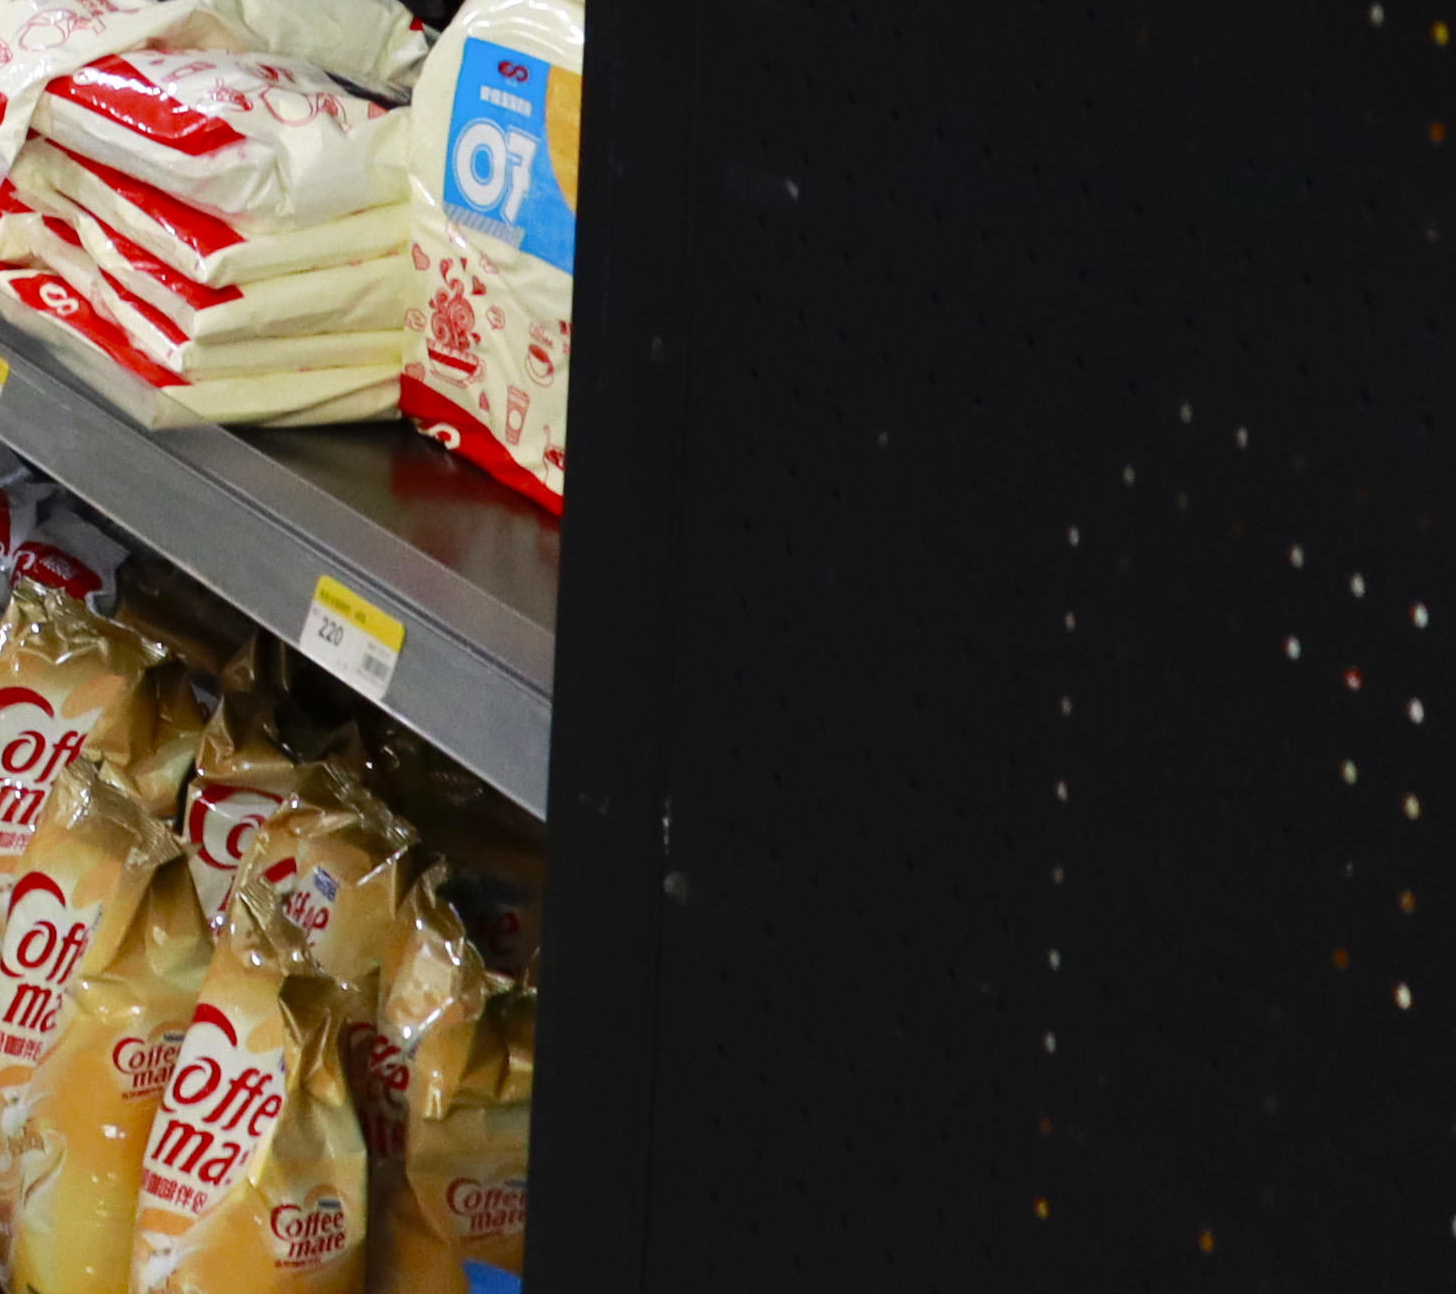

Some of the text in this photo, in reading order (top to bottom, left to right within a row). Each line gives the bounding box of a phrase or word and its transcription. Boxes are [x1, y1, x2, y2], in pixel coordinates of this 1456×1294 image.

[451, 118, 539, 226] 07
[0, 870, 86, 985] Coff
[3, 982, 58, 1032] ma
[151, 1118, 250, 1185] ma
[270, 1203, 343, 1242] Coffee
[289, 1230, 346, 1259] mate
